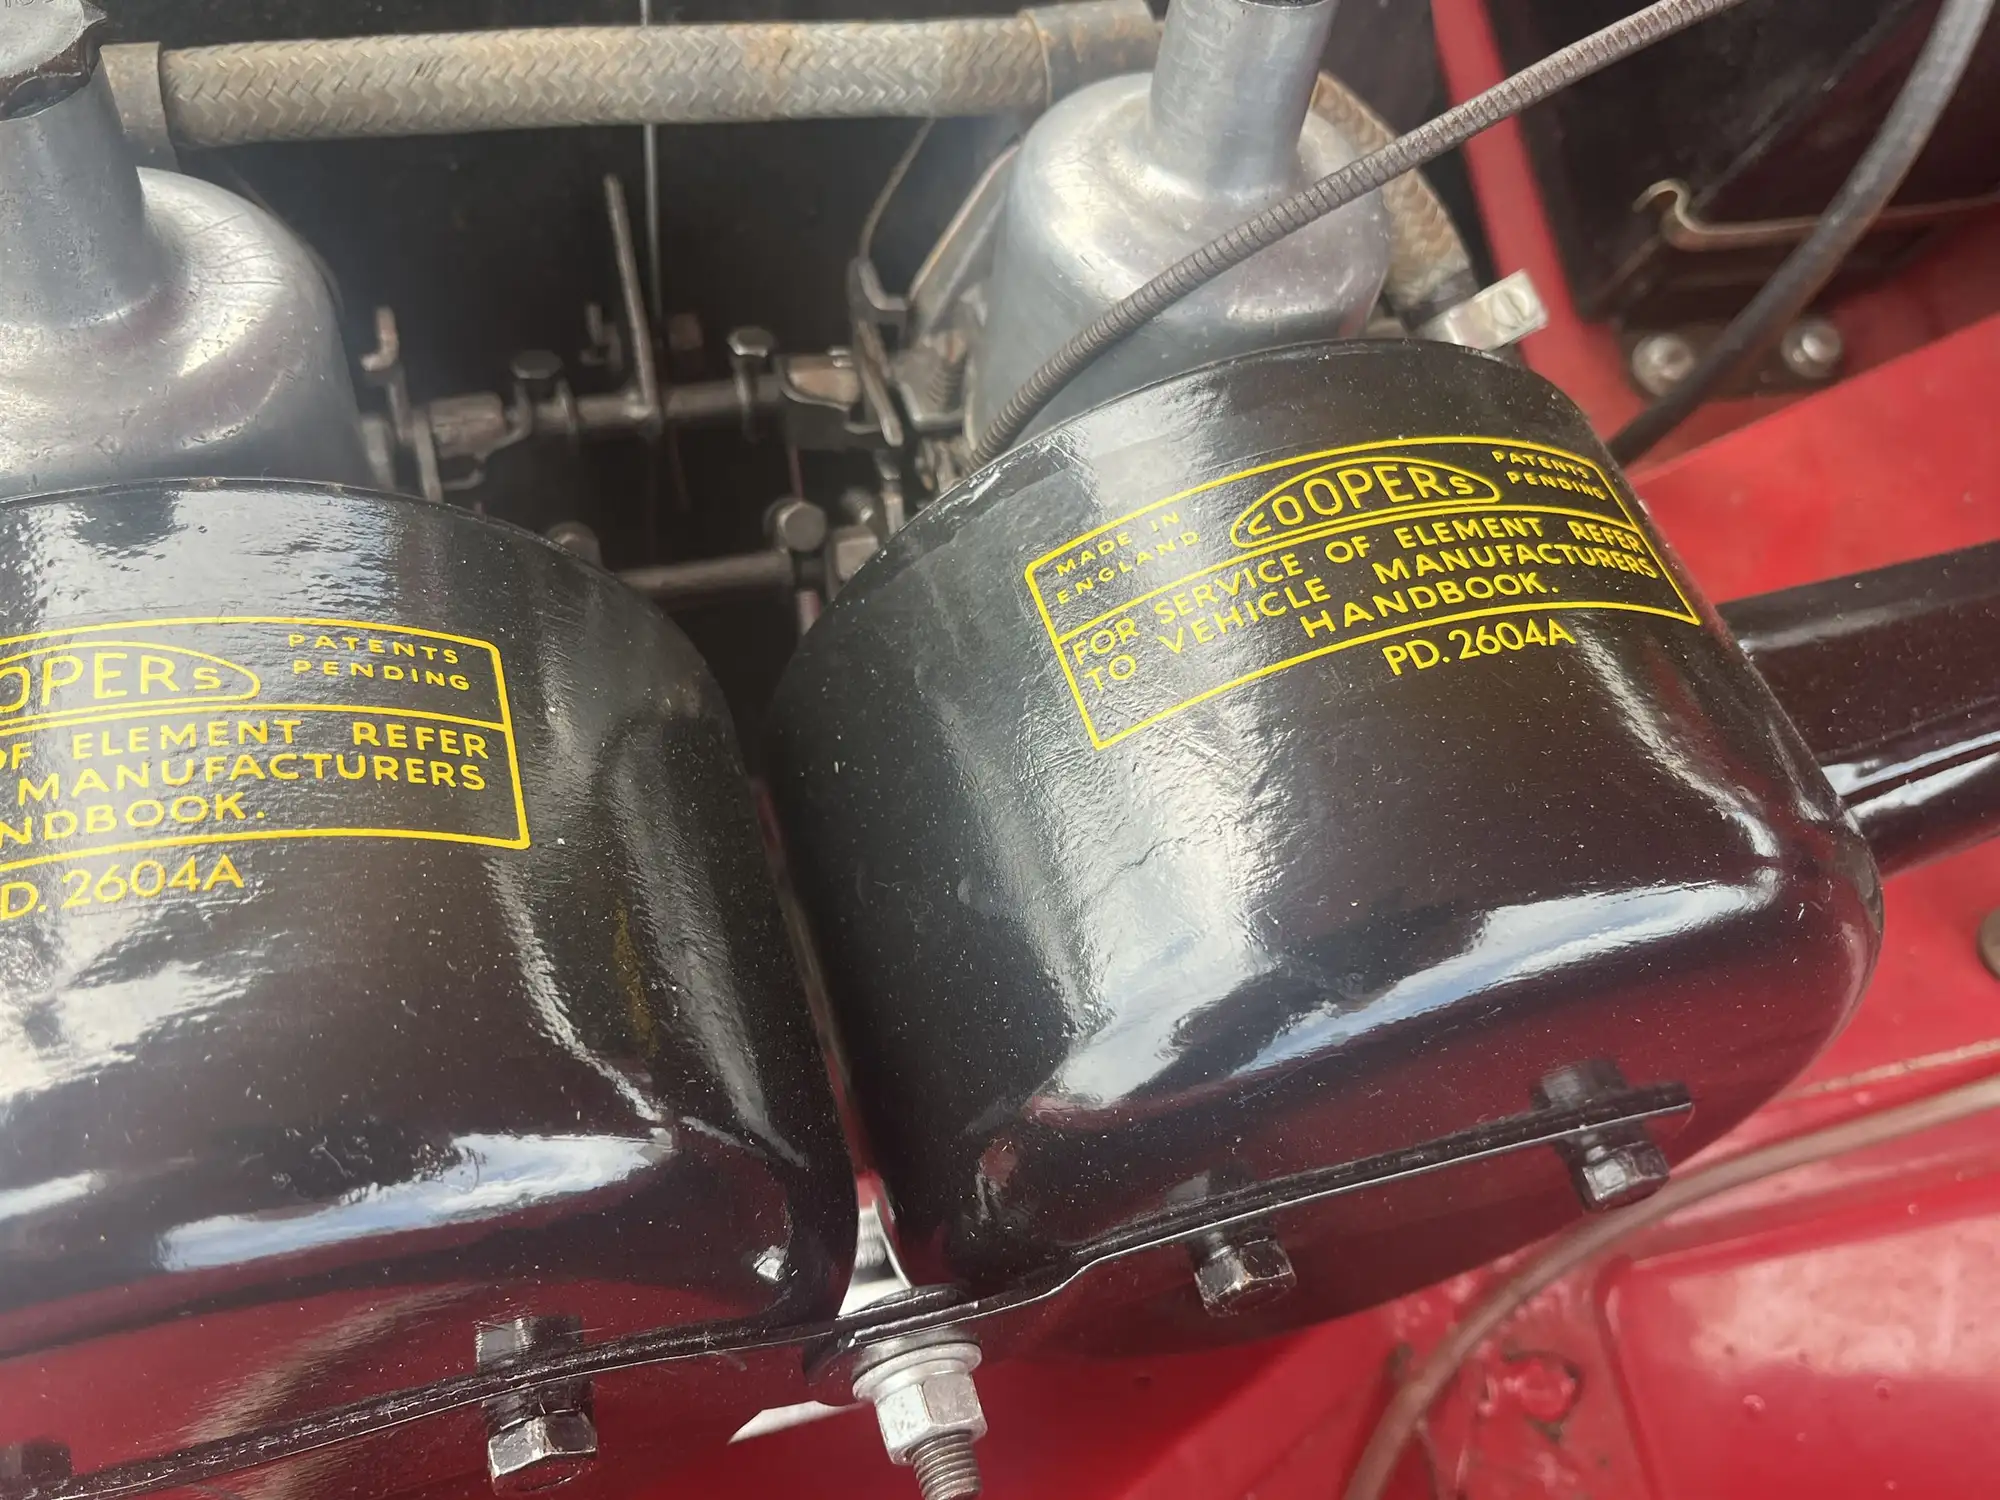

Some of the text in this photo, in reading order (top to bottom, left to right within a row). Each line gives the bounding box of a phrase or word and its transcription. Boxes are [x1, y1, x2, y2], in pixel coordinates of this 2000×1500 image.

[1492, 448, 1590, 481] PATENTS
[1506, 470, 1608, 502] PENDING
[1056, 511, 1180, 577] MADE IN
[1057, 531, 1200, 606] ENGLAND
[1073, 516, 1645, 664] FOR SERVICE OF ELEMENT REFER
[1085, 542, 1659, 692] TO VEHICLE MANUFACTURERS
[1299, 572, 1560, 638] HANDBOOK.
[289, 633, 459, 664] PATENTS
[293, 659, 471, 691] PENDING
[73, 720, 302, 760] ELEMENT
[352, 721, 488, 760] REFER
[17, 752, 486, 806] MANUFACTURERS
